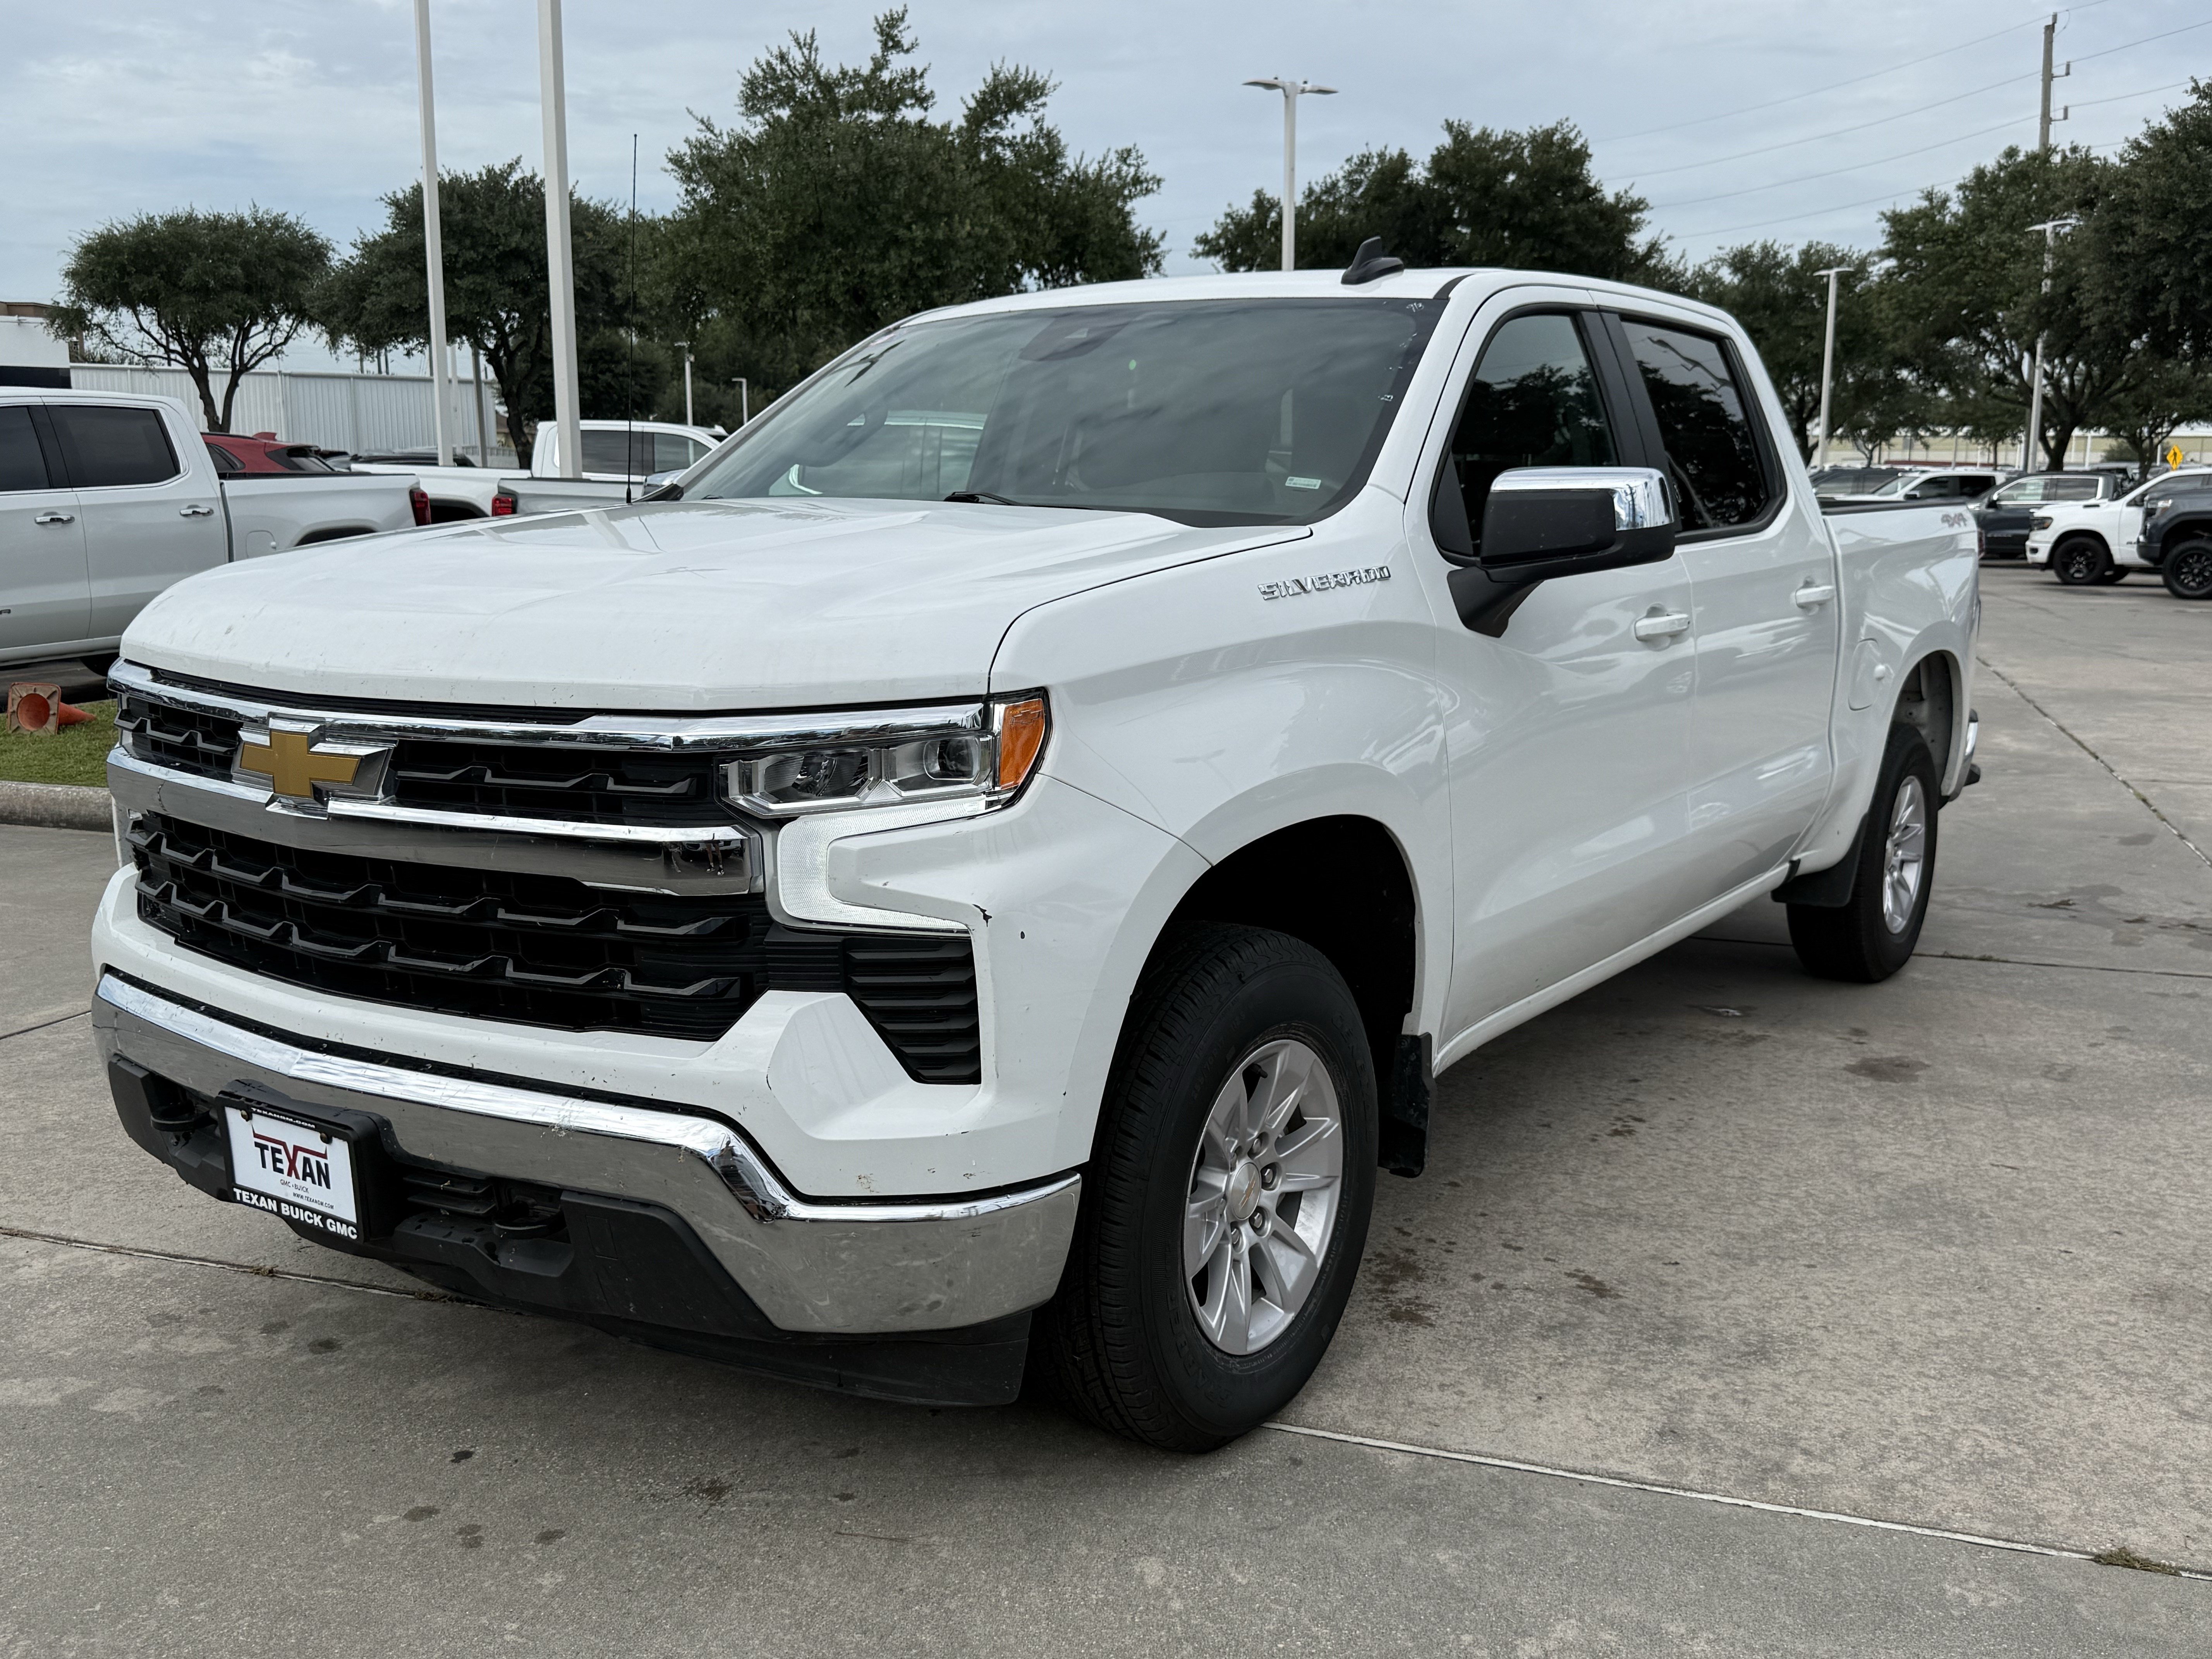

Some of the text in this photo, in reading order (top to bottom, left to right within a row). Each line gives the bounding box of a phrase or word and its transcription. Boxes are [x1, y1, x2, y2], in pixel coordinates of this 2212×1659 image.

[1257, 565, 1391, 601] SILVERADO
[251, 1107, 315, 1128] TEXANGM.COM
[253, 1140, 331, 1190] TEXAN
[233, 1188, 358, 1240] TEXAN BUICK GMC
